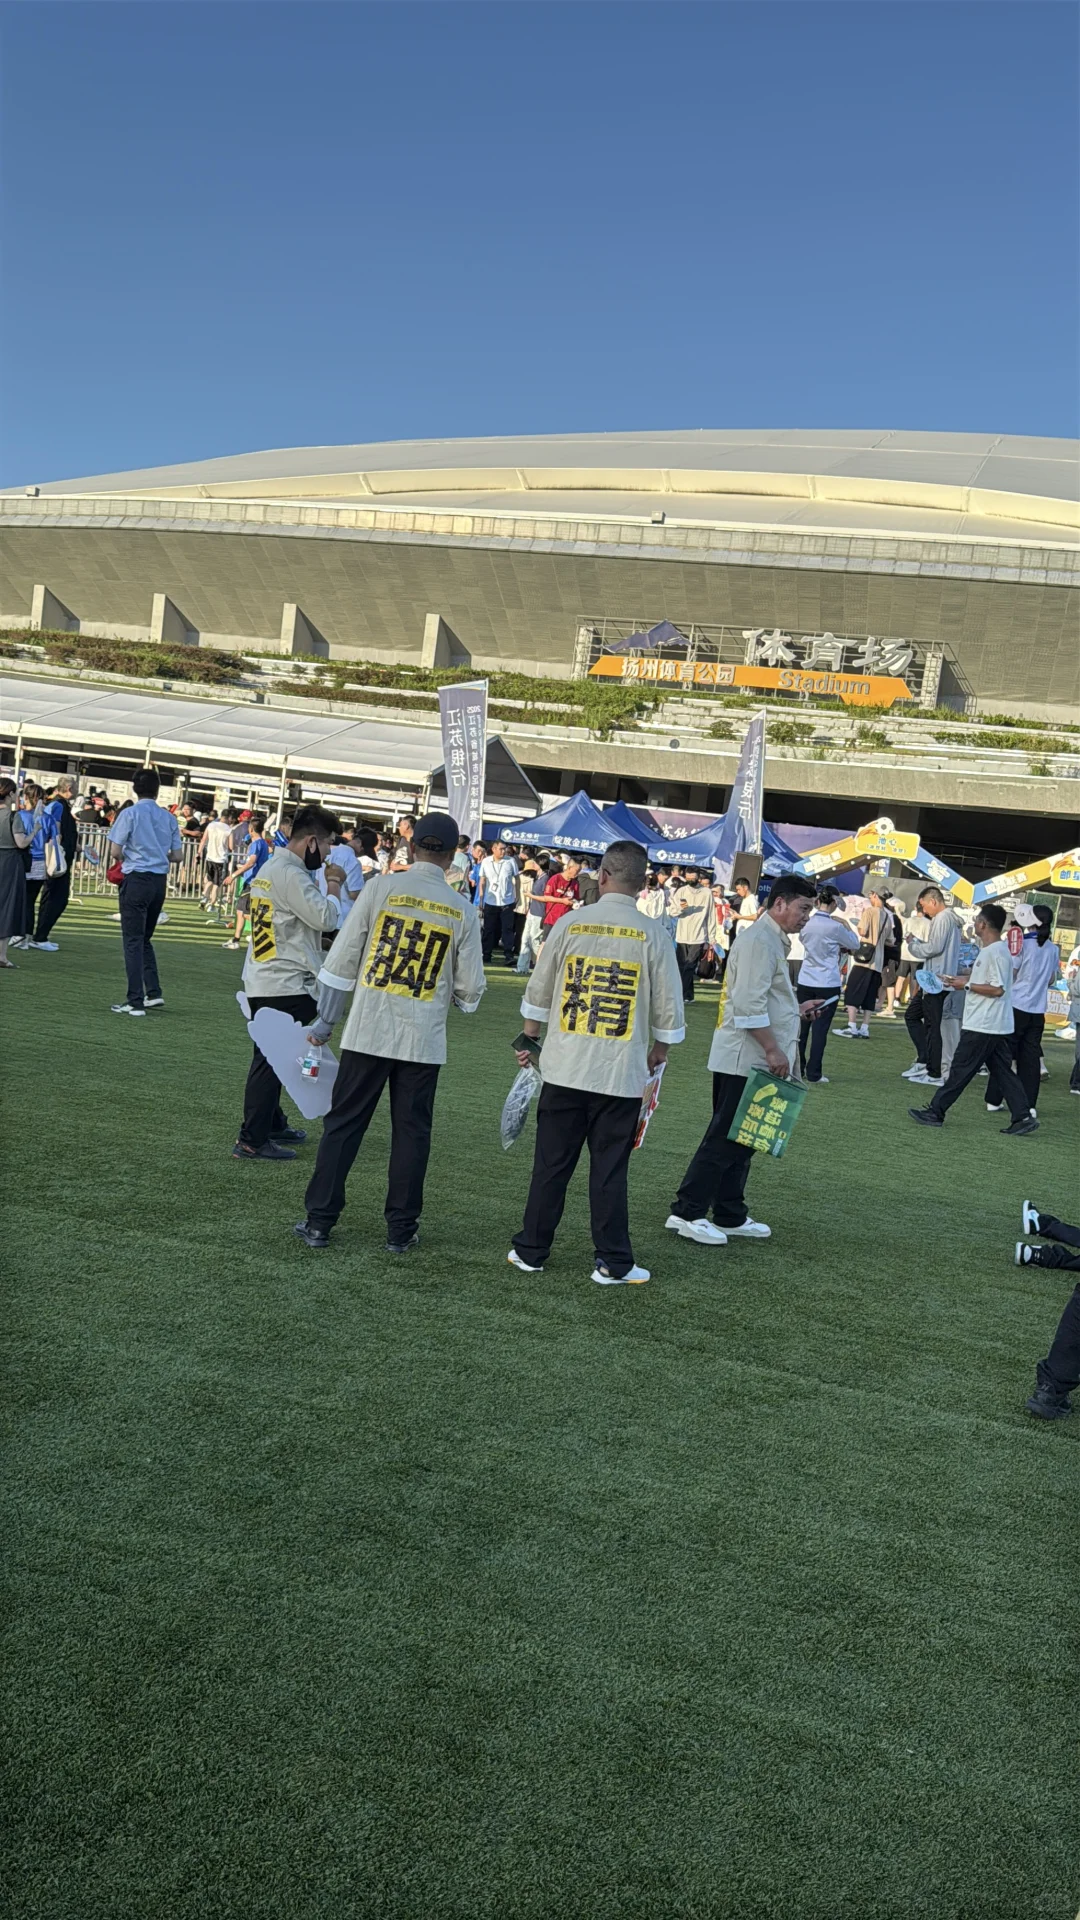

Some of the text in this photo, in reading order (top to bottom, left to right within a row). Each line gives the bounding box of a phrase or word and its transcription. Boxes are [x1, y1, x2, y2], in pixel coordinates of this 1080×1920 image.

[621, 657, 735, 686] 扬州体育公园
[742, 628, 914, 676] 体育场
[778, 670, 870, 695] Stadium
[364, 914, 451, 998] 脚
[562, 957, 638, 1037] 精
